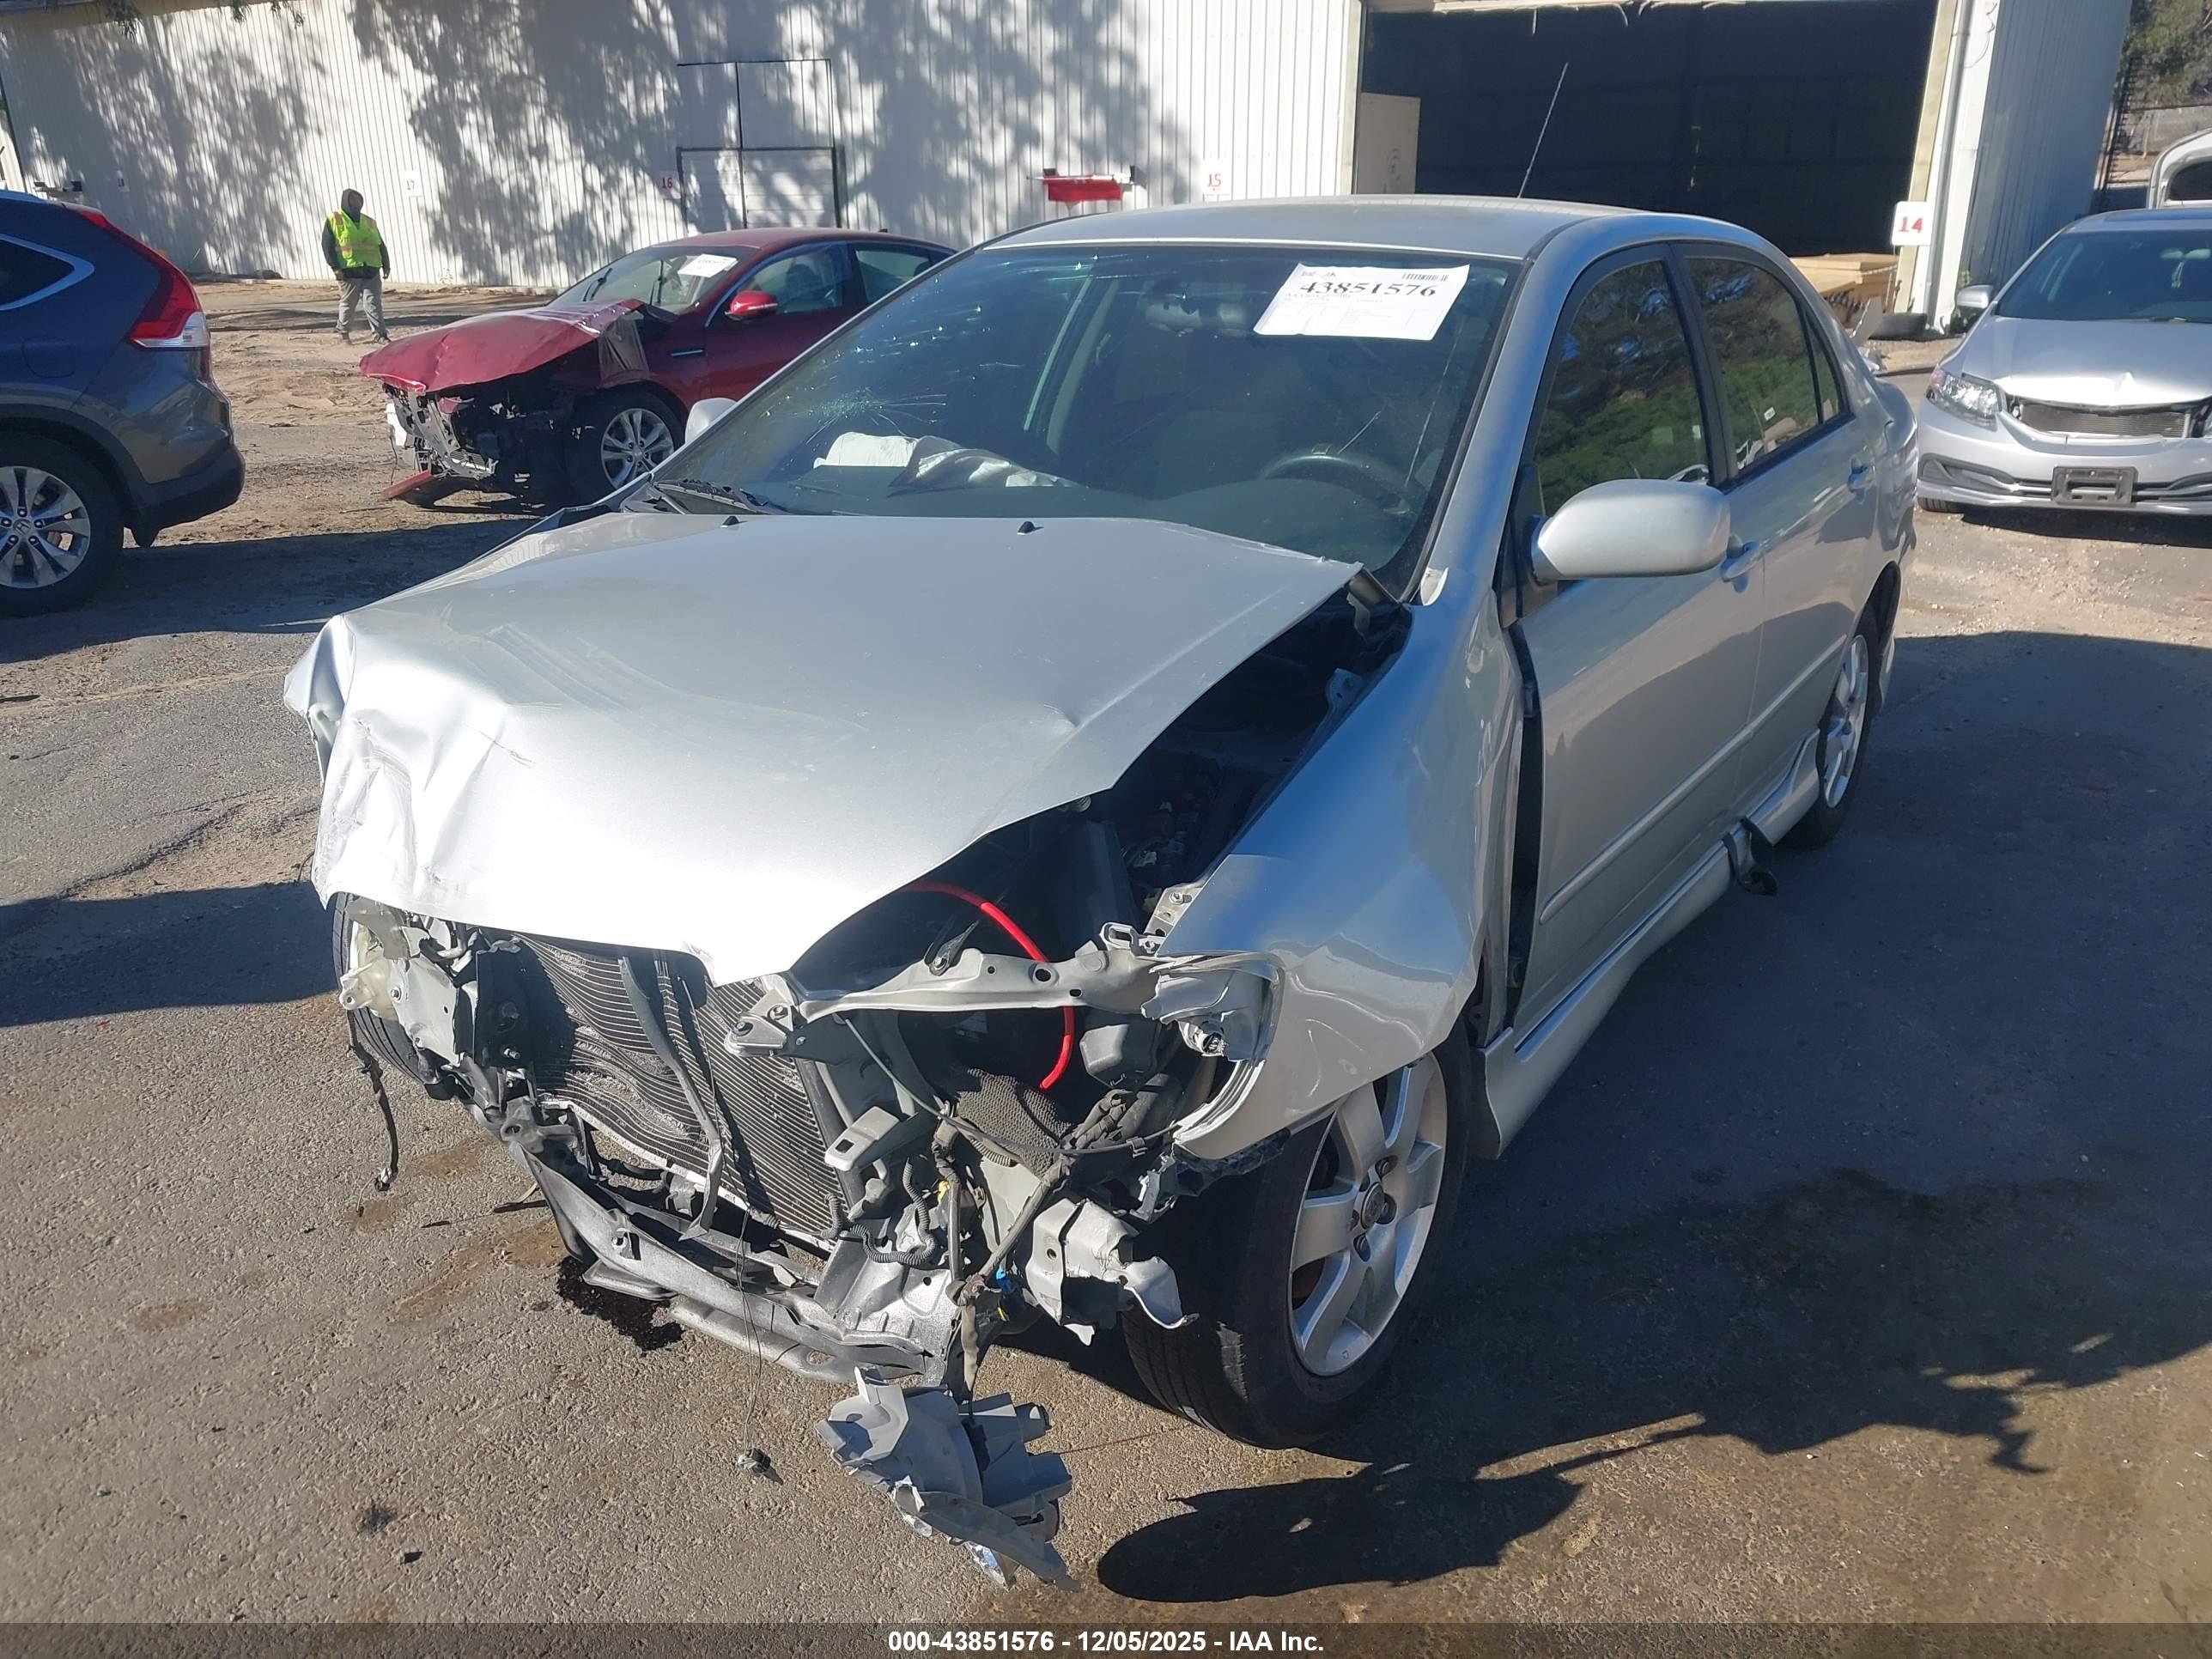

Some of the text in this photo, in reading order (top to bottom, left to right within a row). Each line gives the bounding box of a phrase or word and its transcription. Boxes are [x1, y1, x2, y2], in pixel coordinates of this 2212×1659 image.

[406, 179, 416, 191] 17
[662, 177, 673, 189] 16
[1207, 173, 1222, 187] 15
[1898, 216, 1923, 234] 14
[1299, 281, 1437, 297] 43851576
